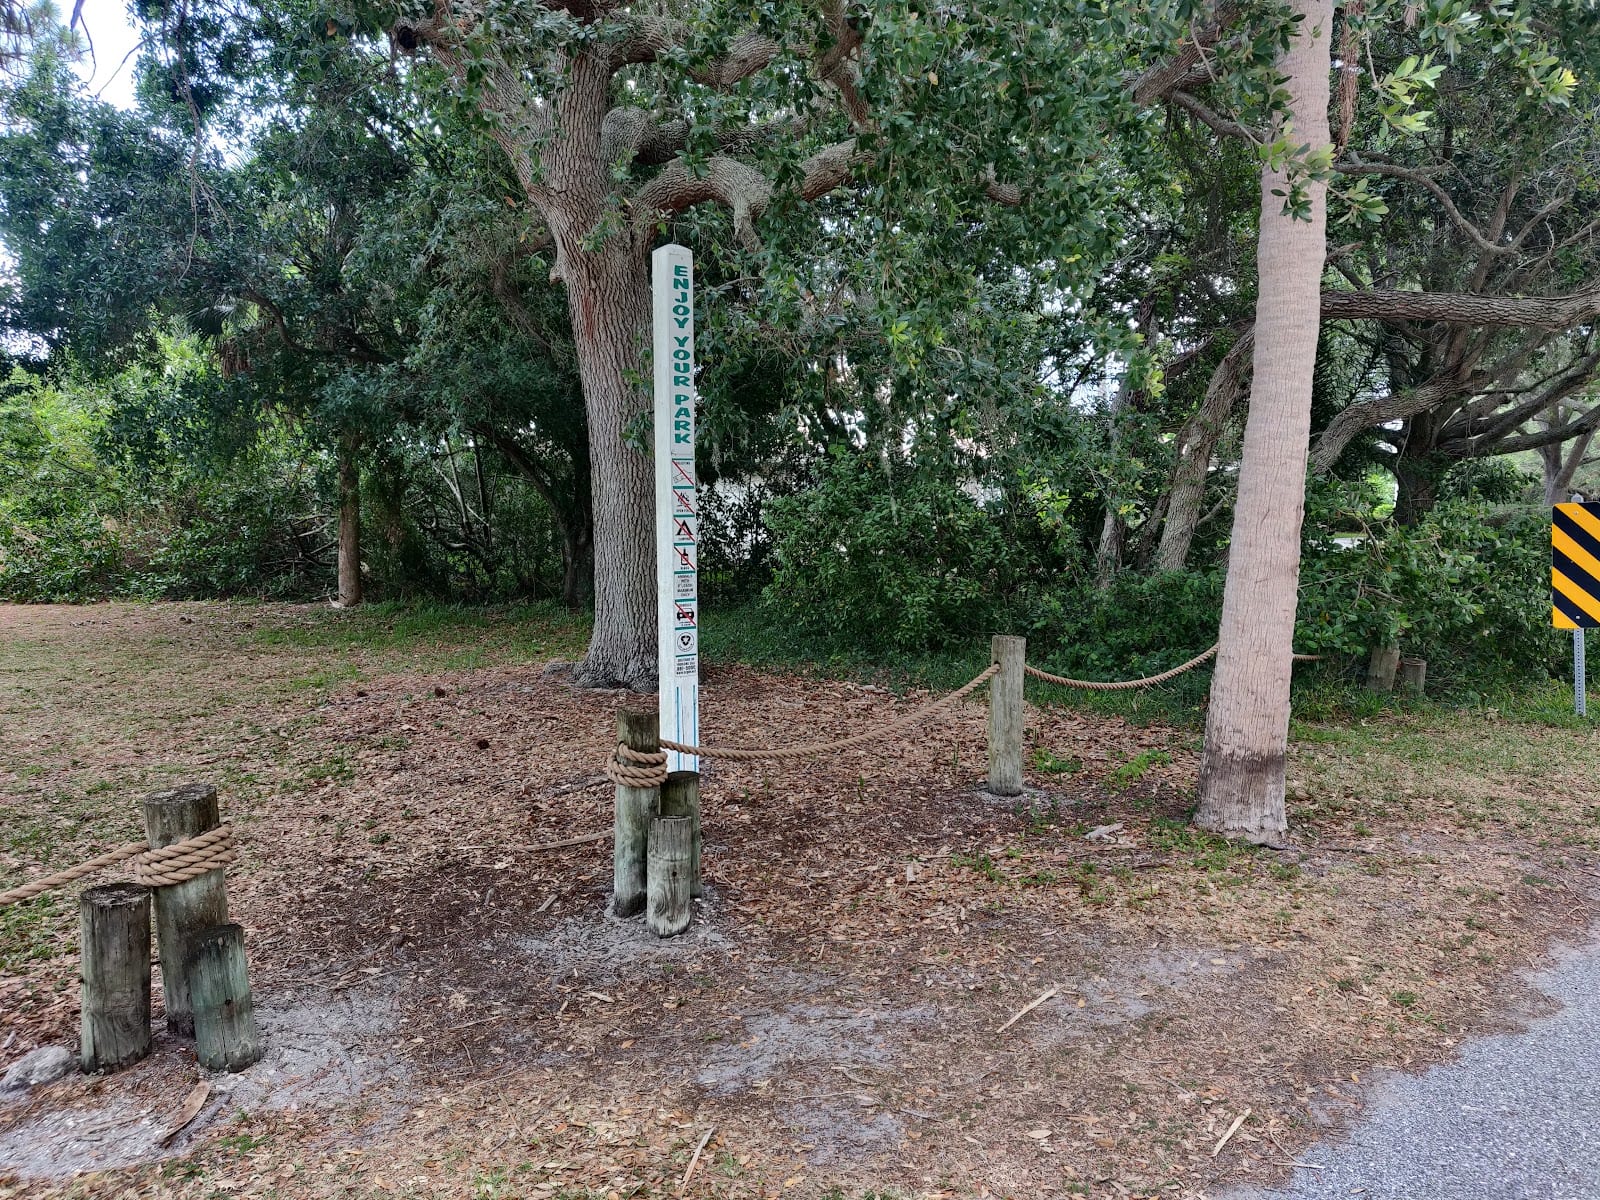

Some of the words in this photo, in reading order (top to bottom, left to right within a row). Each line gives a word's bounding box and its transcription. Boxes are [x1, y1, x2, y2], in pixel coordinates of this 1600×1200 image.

[673, 264, 690, 329] ENJOY
[673, 336, 691, 387] YOUR
[674, 394, 691, 444] PARK
